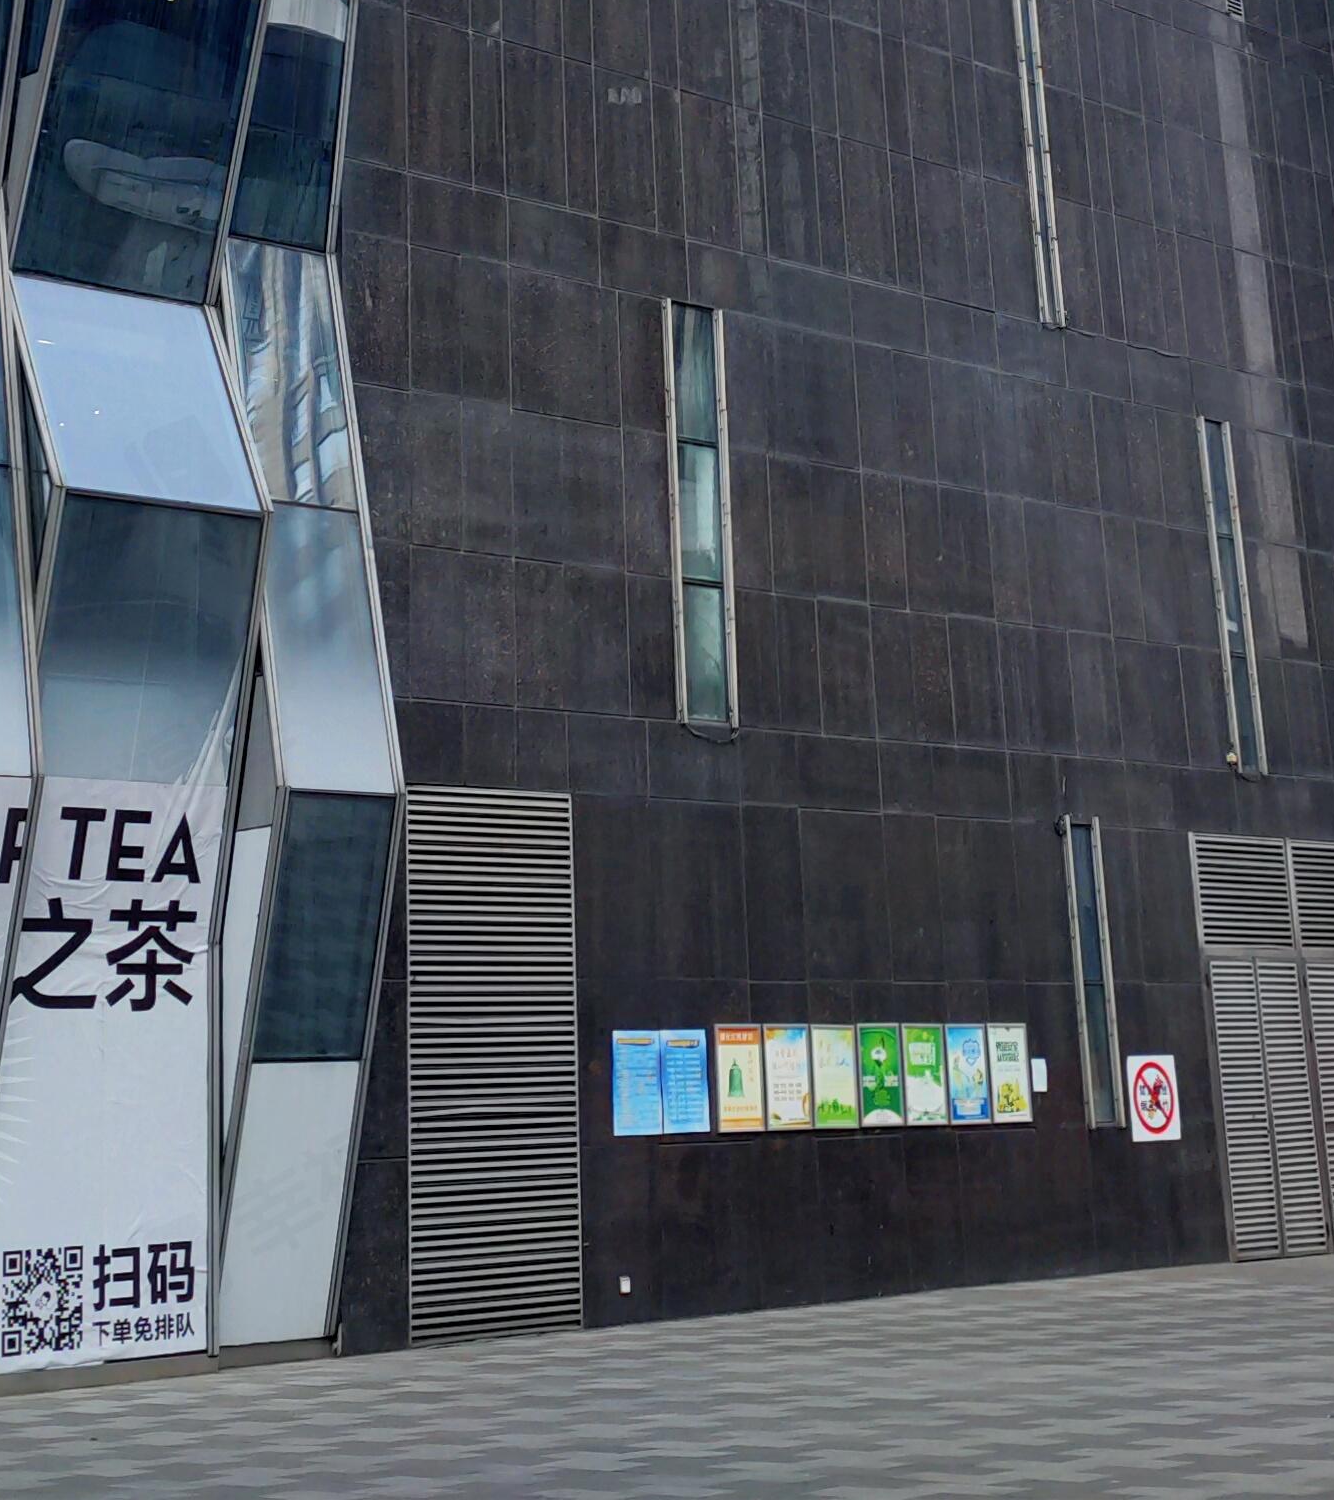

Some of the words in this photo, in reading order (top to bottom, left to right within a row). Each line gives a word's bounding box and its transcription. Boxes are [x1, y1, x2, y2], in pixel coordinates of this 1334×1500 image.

[59, 806, 201, 885] TEA
[9, 896, 198, 1012] 之茶
[92, 1241, 194, 1312] 扫码
[92, 1314, 196, 1348] 下单免排队
